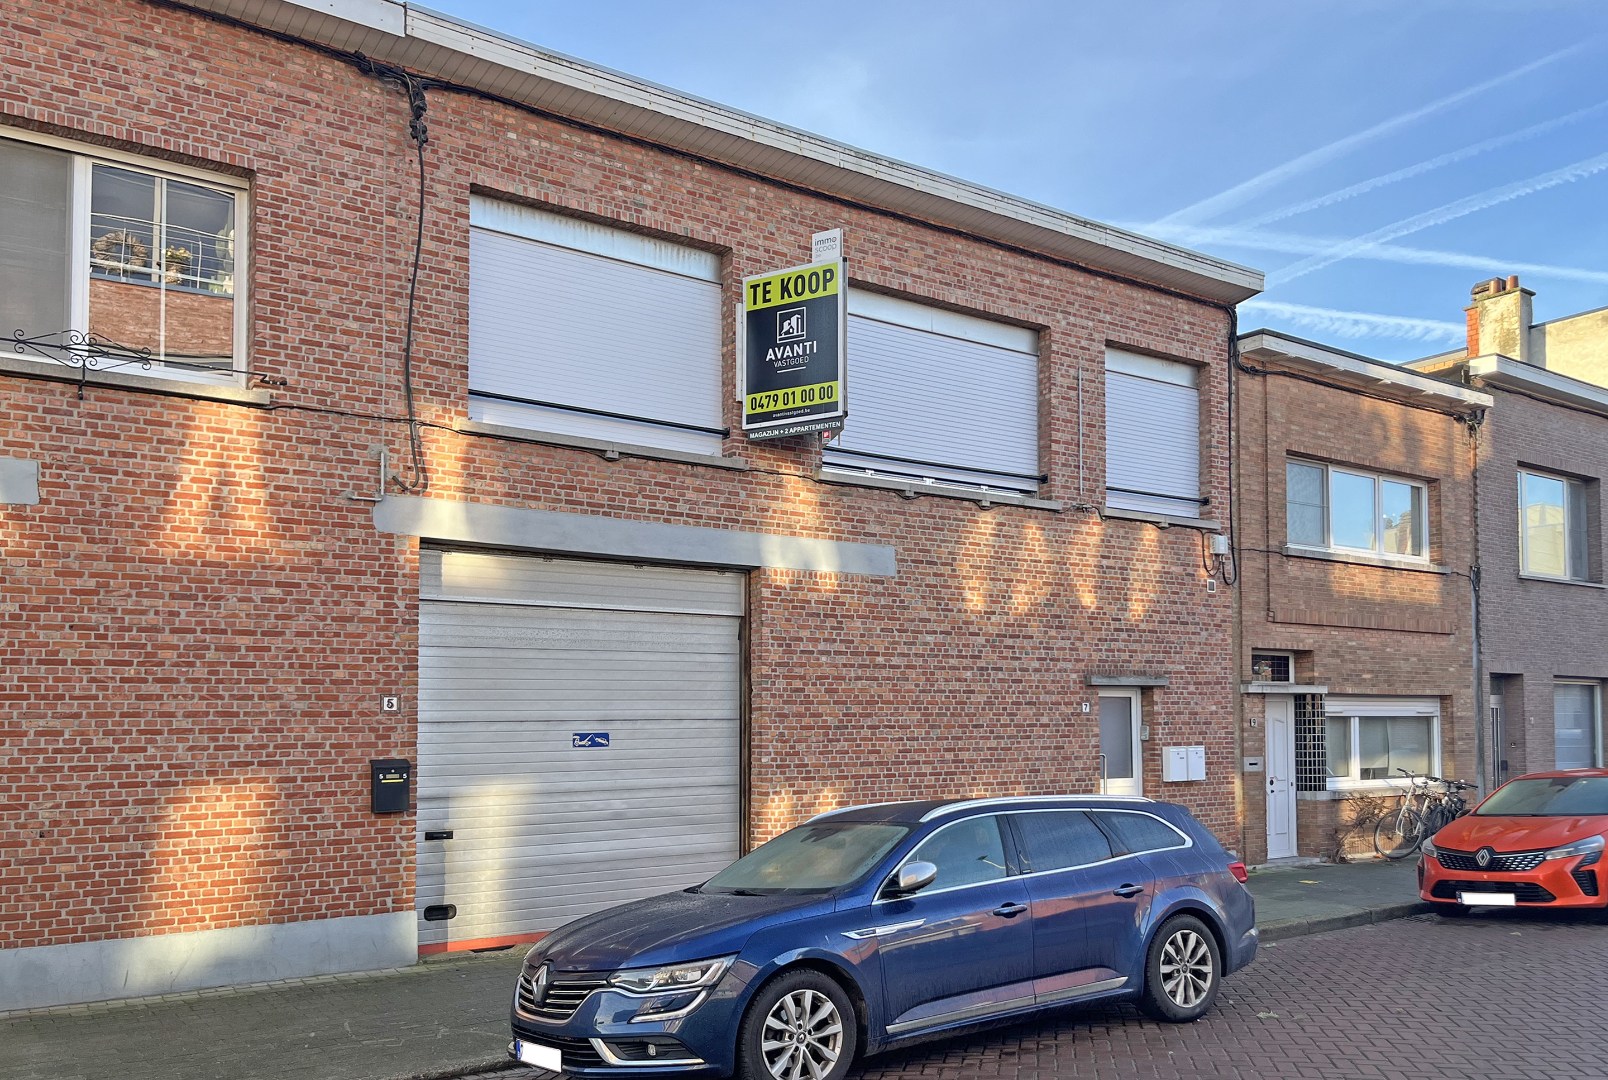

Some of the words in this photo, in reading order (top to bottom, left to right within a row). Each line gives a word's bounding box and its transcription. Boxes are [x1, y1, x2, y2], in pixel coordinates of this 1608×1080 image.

[815, 237, 836, 246] immo
[815, 244, 837, 253] scoop
[750, 281, 771, 305] TE
[780, 268, 834, 300] KOOP
[766, 341, 816, 361] AVANTI
[774, 356, 809, 367] VASTGOED
[751, 394, 778, 410] 0479
[783, 391, 796, 405] 01
[801, 388, 814, 403] 00
[819, 385, 833, 400] 00
[750, 430, 779, 438] MAGAZIJN
[789, 421, 840, 433] APPARTEMENTEN
[387, 699, 394, 709] 5
